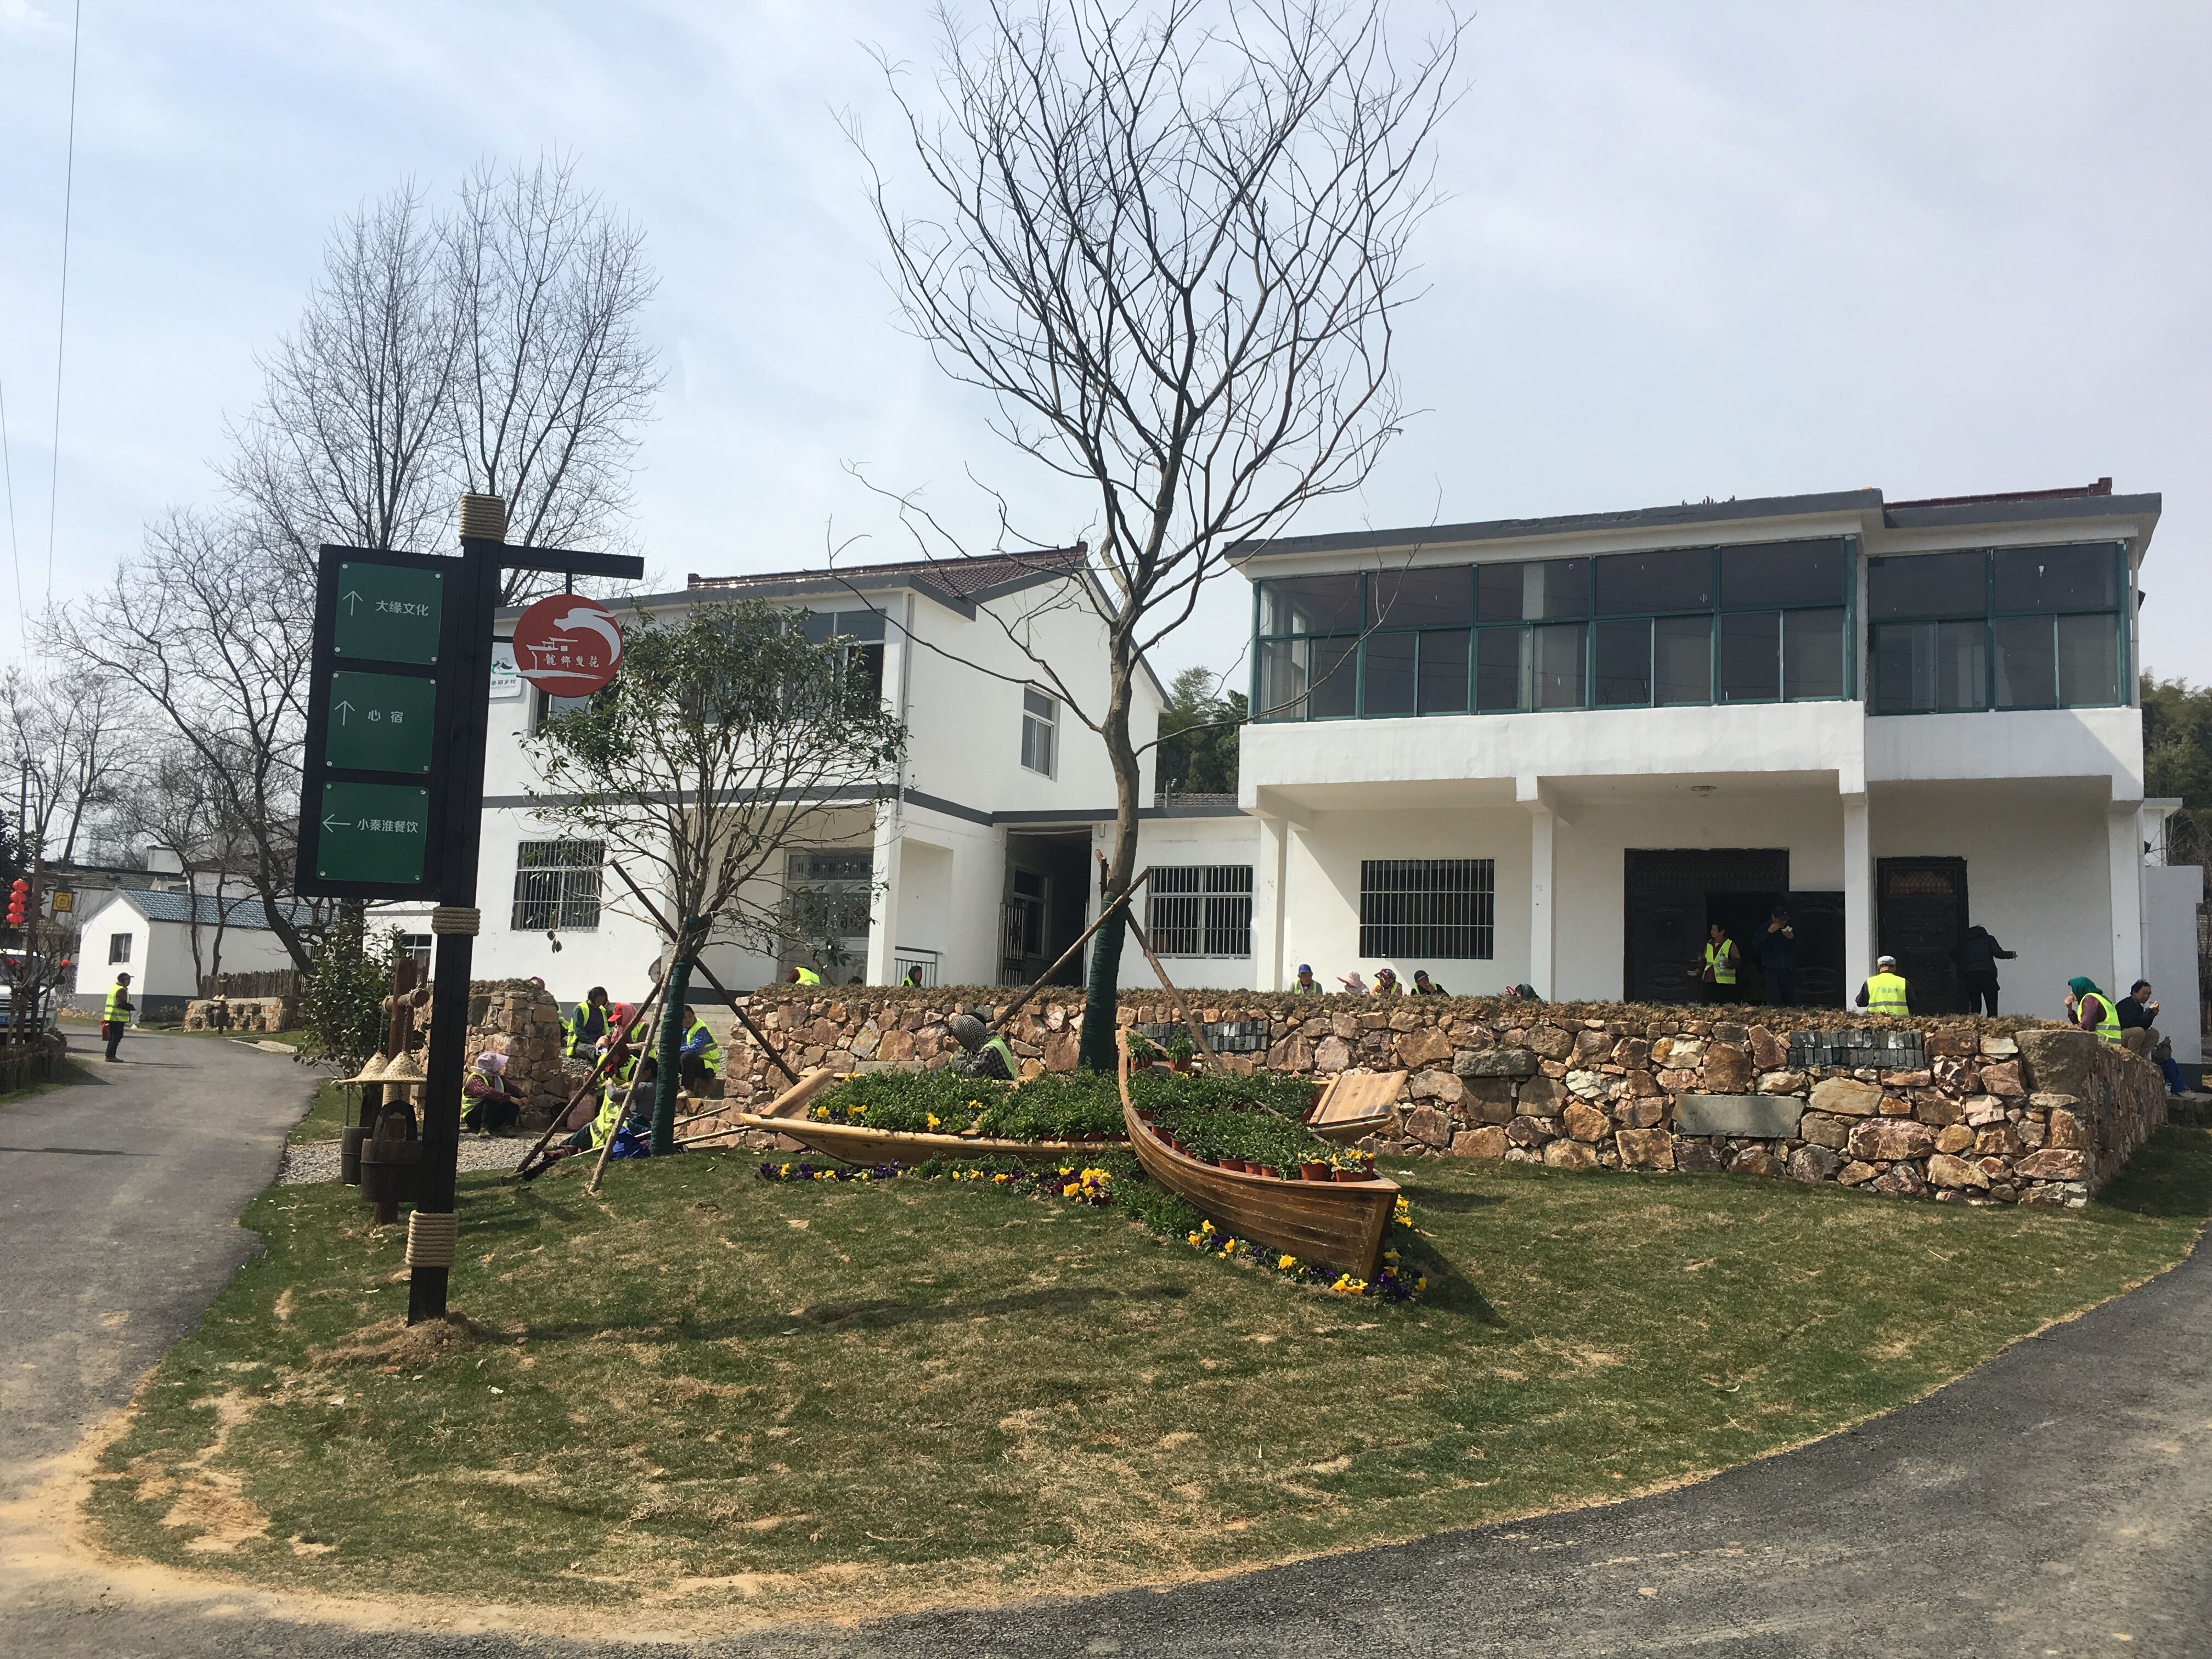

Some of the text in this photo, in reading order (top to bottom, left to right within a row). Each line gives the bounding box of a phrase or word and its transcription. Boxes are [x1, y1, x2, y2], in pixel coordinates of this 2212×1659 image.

[375, 600, 429, 616] 大缘文化
[357, 818, 418, 833] 小秦淮餐饮
